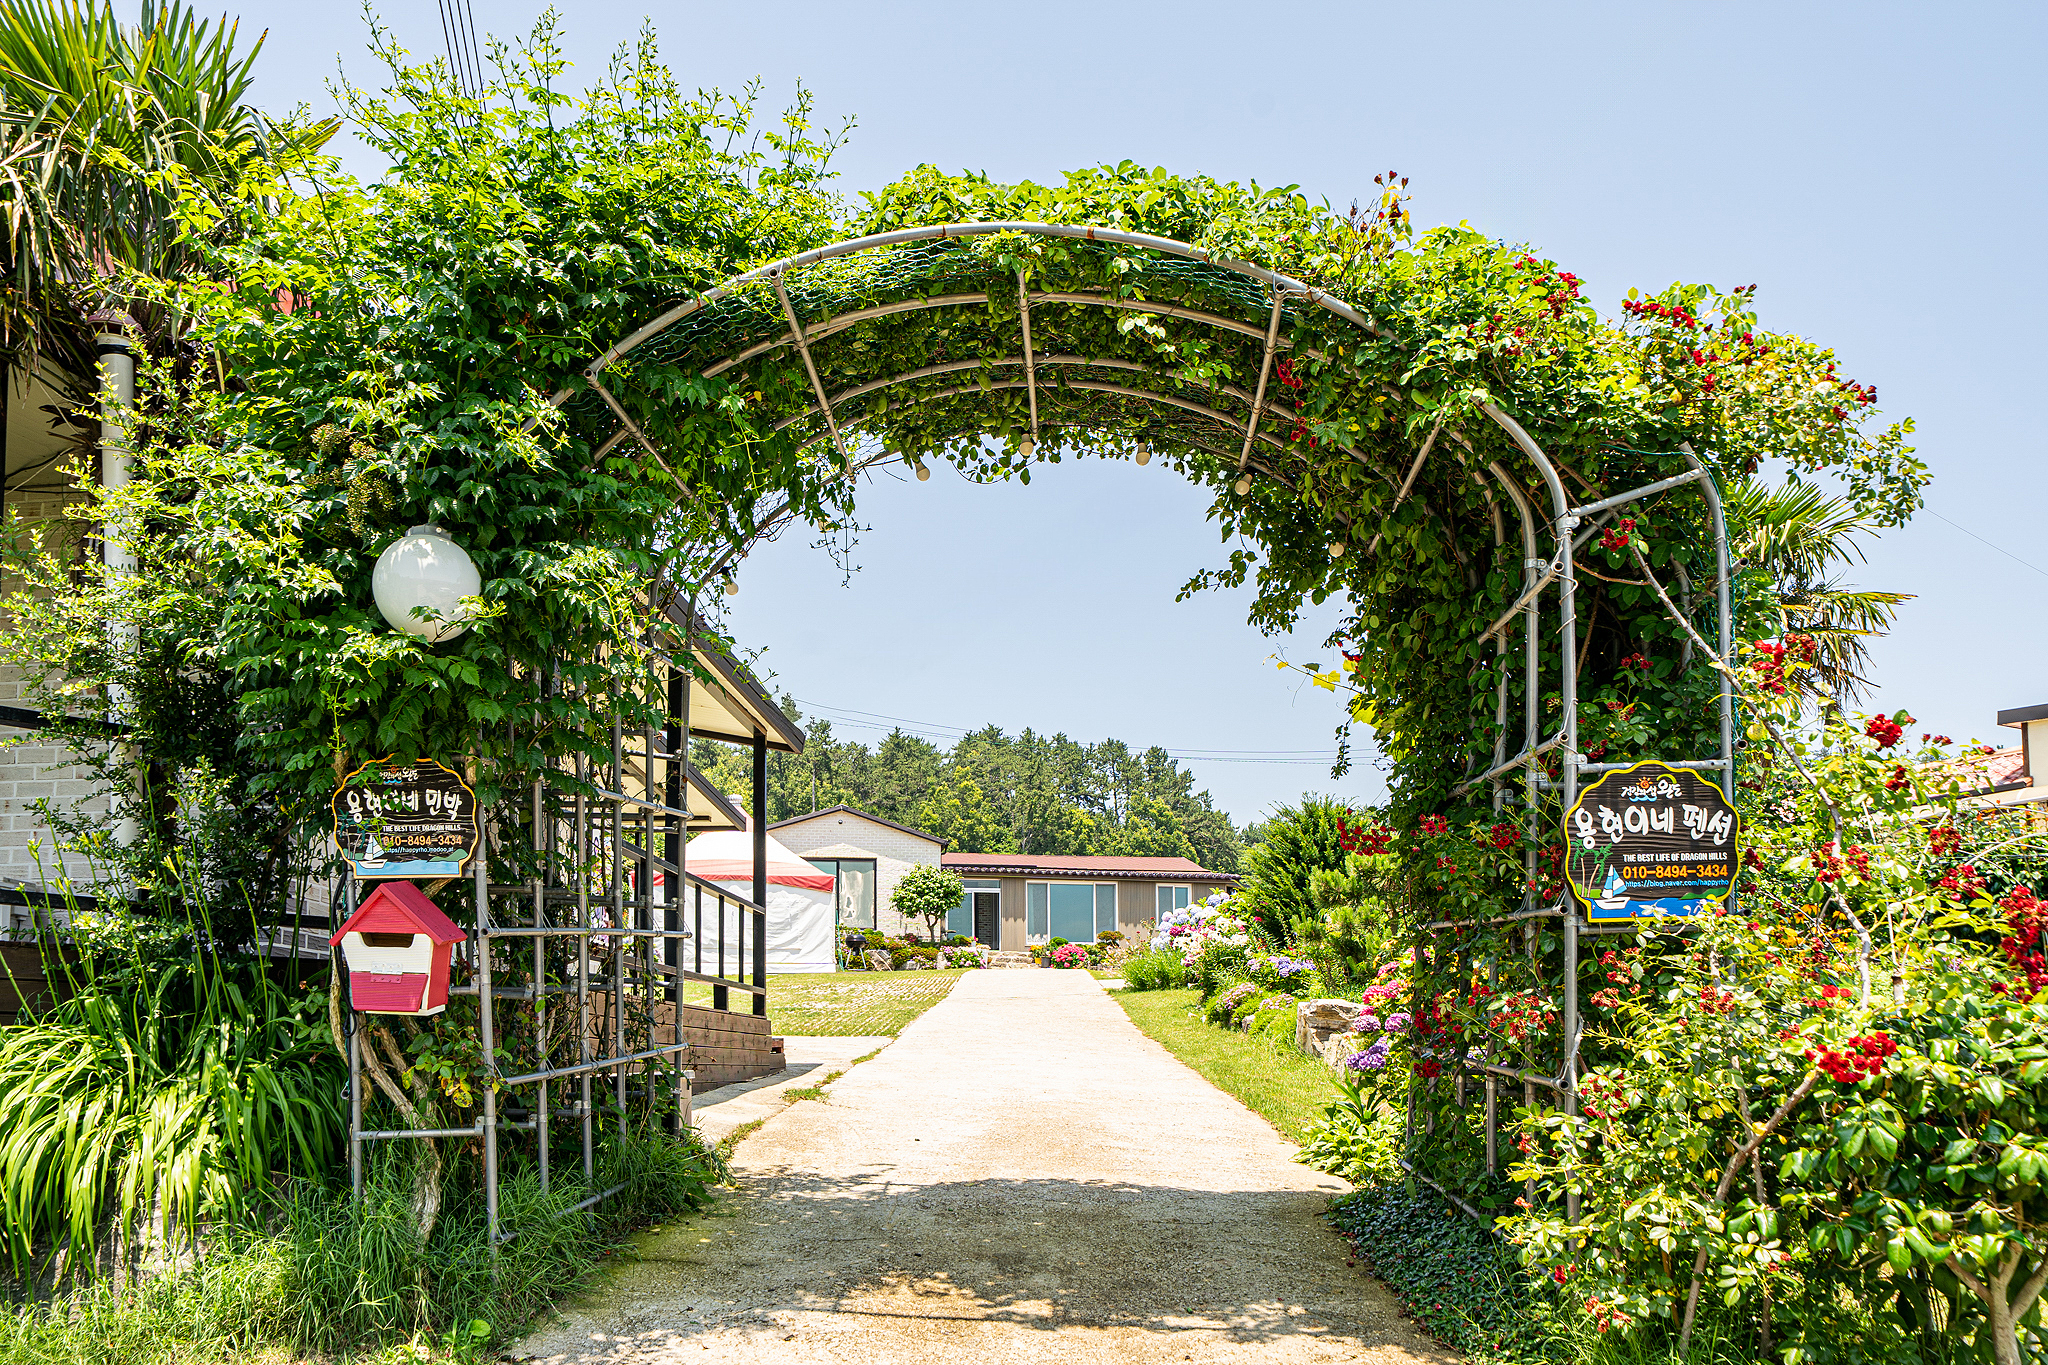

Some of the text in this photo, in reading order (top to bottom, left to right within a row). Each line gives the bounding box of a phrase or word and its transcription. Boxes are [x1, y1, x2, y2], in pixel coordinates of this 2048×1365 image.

[425, 789, 463, 821] 민박
[408, 824, 421, 832] LIFE
[1575, 803, 1733, 849] 용현이네 펜션
[382, 835, 463, 846] 010-8494-3434
[1623, 852, 1728, 862] THE BEST LIFE OF DRAGON HILLS
[1622, 864, 1728, 879] 010-8494-3434
